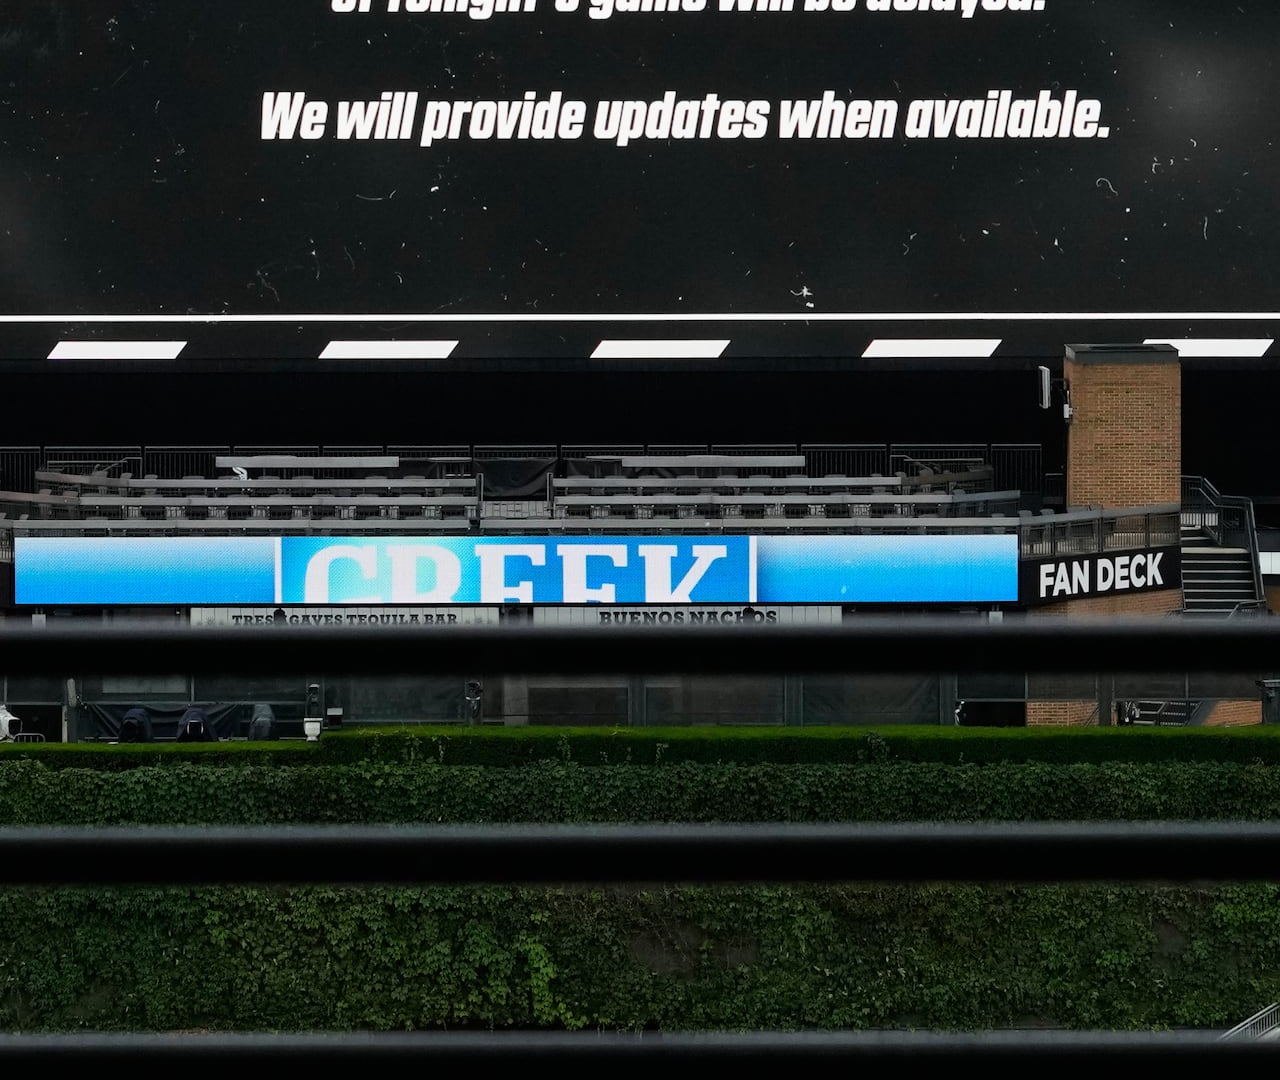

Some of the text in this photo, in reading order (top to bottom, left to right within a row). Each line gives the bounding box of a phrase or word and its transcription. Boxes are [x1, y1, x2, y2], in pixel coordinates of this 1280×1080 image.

[260, 89, 1110, 147] We will provide updates when available.
[1039, 552, 1164, 598] FAN DECK
[232, 614, 458, 625] TRES GAVES TEQUILA BAR
[599, 611, 685, 625] BUENOS
